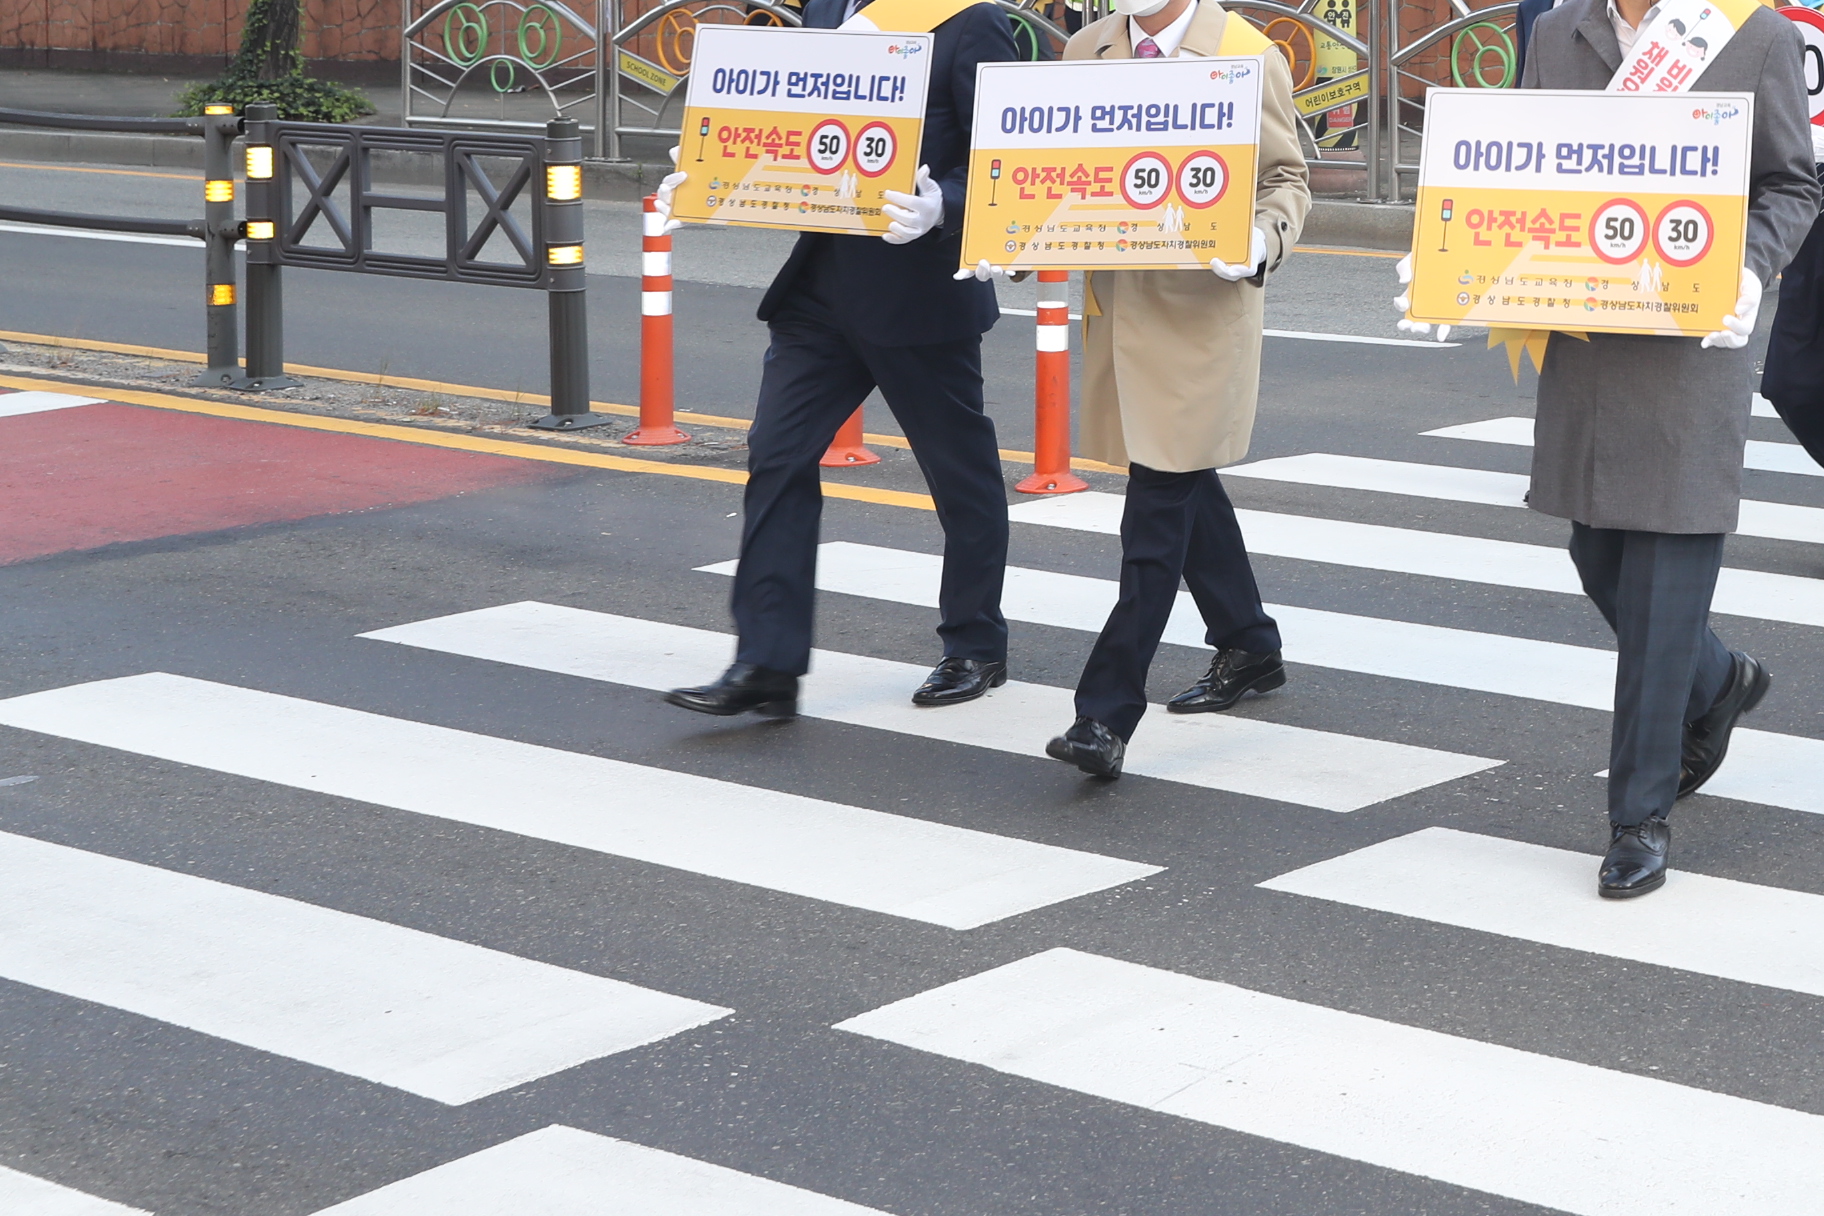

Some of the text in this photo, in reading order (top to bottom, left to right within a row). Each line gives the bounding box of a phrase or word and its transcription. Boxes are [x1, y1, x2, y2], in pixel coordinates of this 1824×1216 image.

[626, 60, 667, 87] SCHOOL ZONE
[712, 67, 906, 103] 아이가 먼저입니다!
[1305, 81, 1361, 108] 어린이보호구역
[1001, 101, 1234, 134] 아이가 먼저입니다!
[717, 125, 887, 161] 안전속도 50 30
[1453, 140, 1720, 177] 아이가 먼저입니다!
[1011, 162, 1215, 200] 안전속도 50 30
[1465, 207, 1699, 250] 안전속도 50 30
[1610, 241, 1690, 251] km/h km/h
[1600, 299, 1699, 314] 경상남도자치경찰위원회
